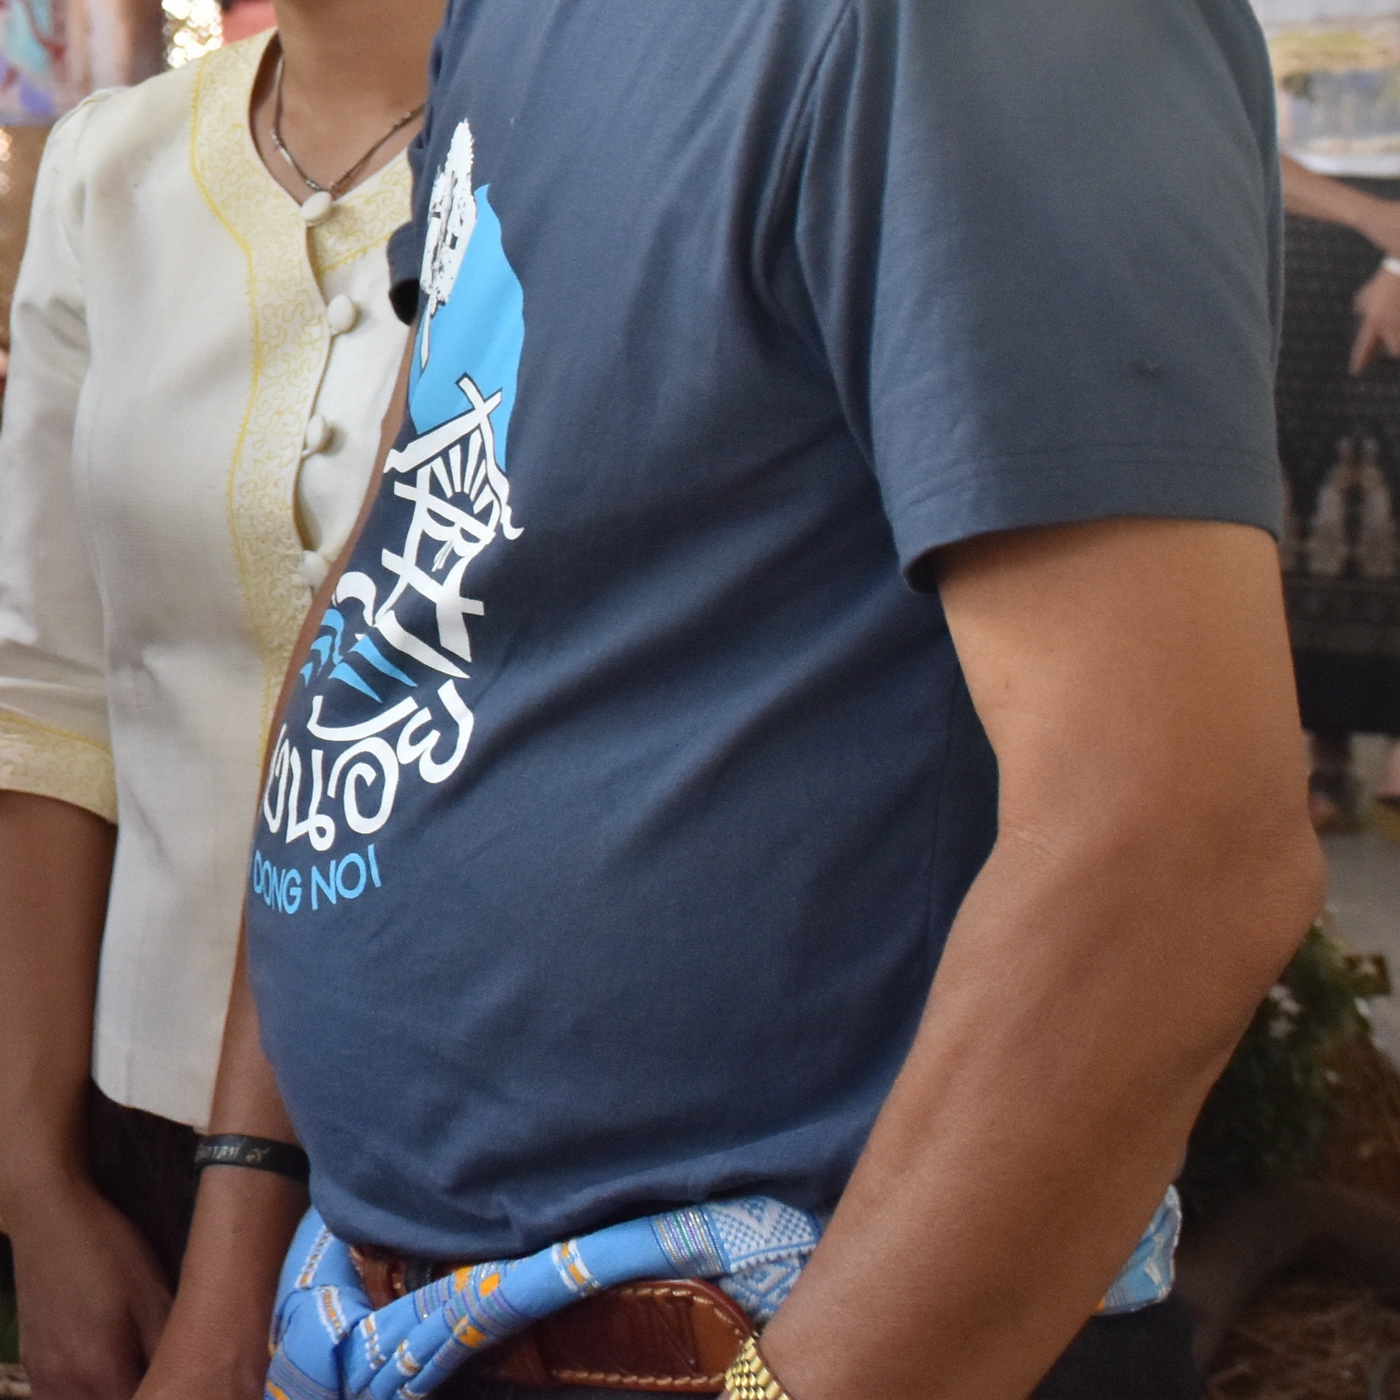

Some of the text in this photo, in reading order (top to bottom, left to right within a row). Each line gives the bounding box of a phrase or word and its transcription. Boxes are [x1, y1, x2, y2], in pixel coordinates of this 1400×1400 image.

[264, 679, 475, 851] งน้อย
[254, 844, 382, 915] DONG NOI
